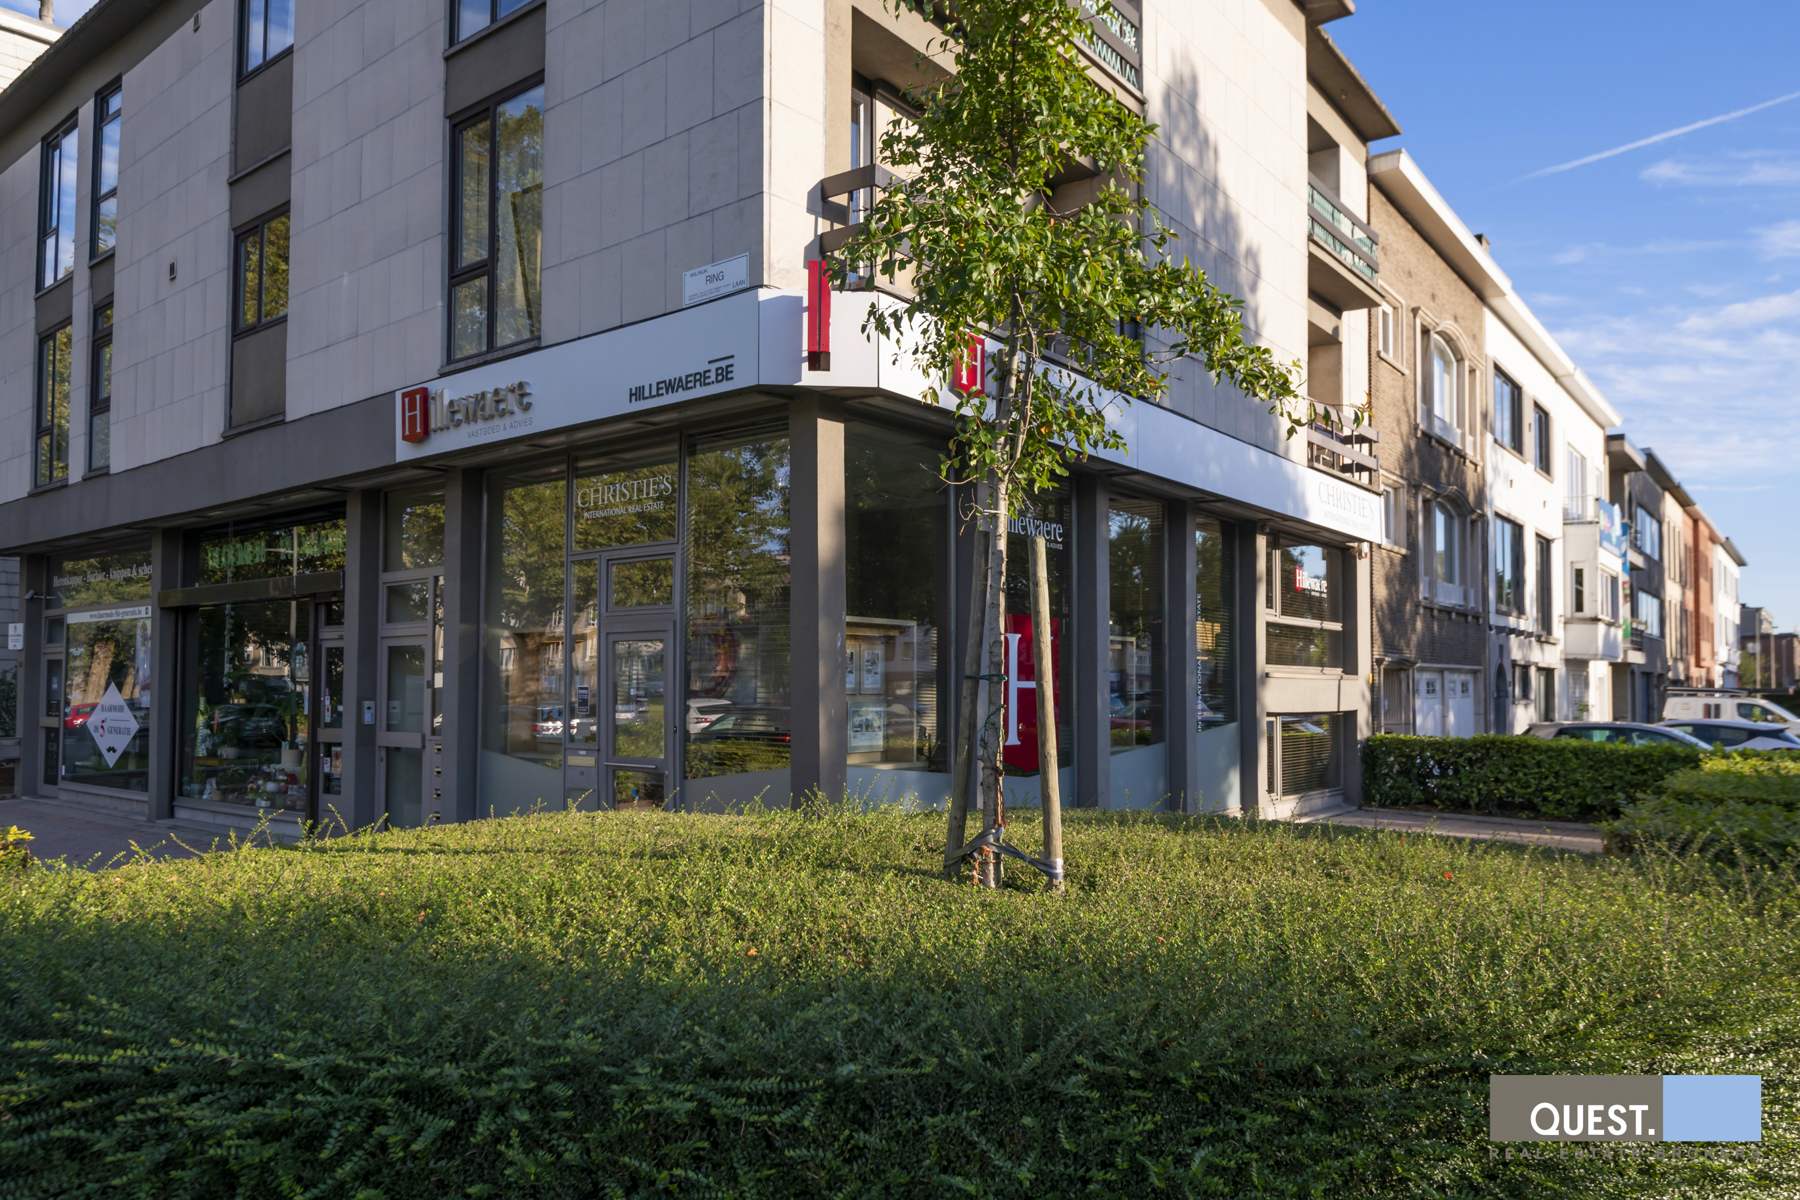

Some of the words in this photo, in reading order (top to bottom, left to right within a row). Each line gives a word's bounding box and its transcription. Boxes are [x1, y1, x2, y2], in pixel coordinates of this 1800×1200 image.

[705, 271, 725, 285] RING
[732, 279, 746, 288] LAAN
[628, 363, 735, 404] HILLEWAERE.BE
[404, 380, 533, 436] Hillewaere
[467, 424, 501, 439] VASTGOED
[502, 423, 508, 432] &
[509, 416, 534, 430] ADVIES
[577, 474, 673, 508] CHRISTIE'S
[1318, 480, 1375, 521] CHRISTIE'S
[583, 506, 628, 520] INTERNATIONAL
[628, 503, 643, 514] REAL
[643, 500, 665, 512] ESTATE
[101, 704, 125, 714] HAARMODE
[93, 725, 100, 734] DE
[107, 725, 131, 736] GENERATIE
